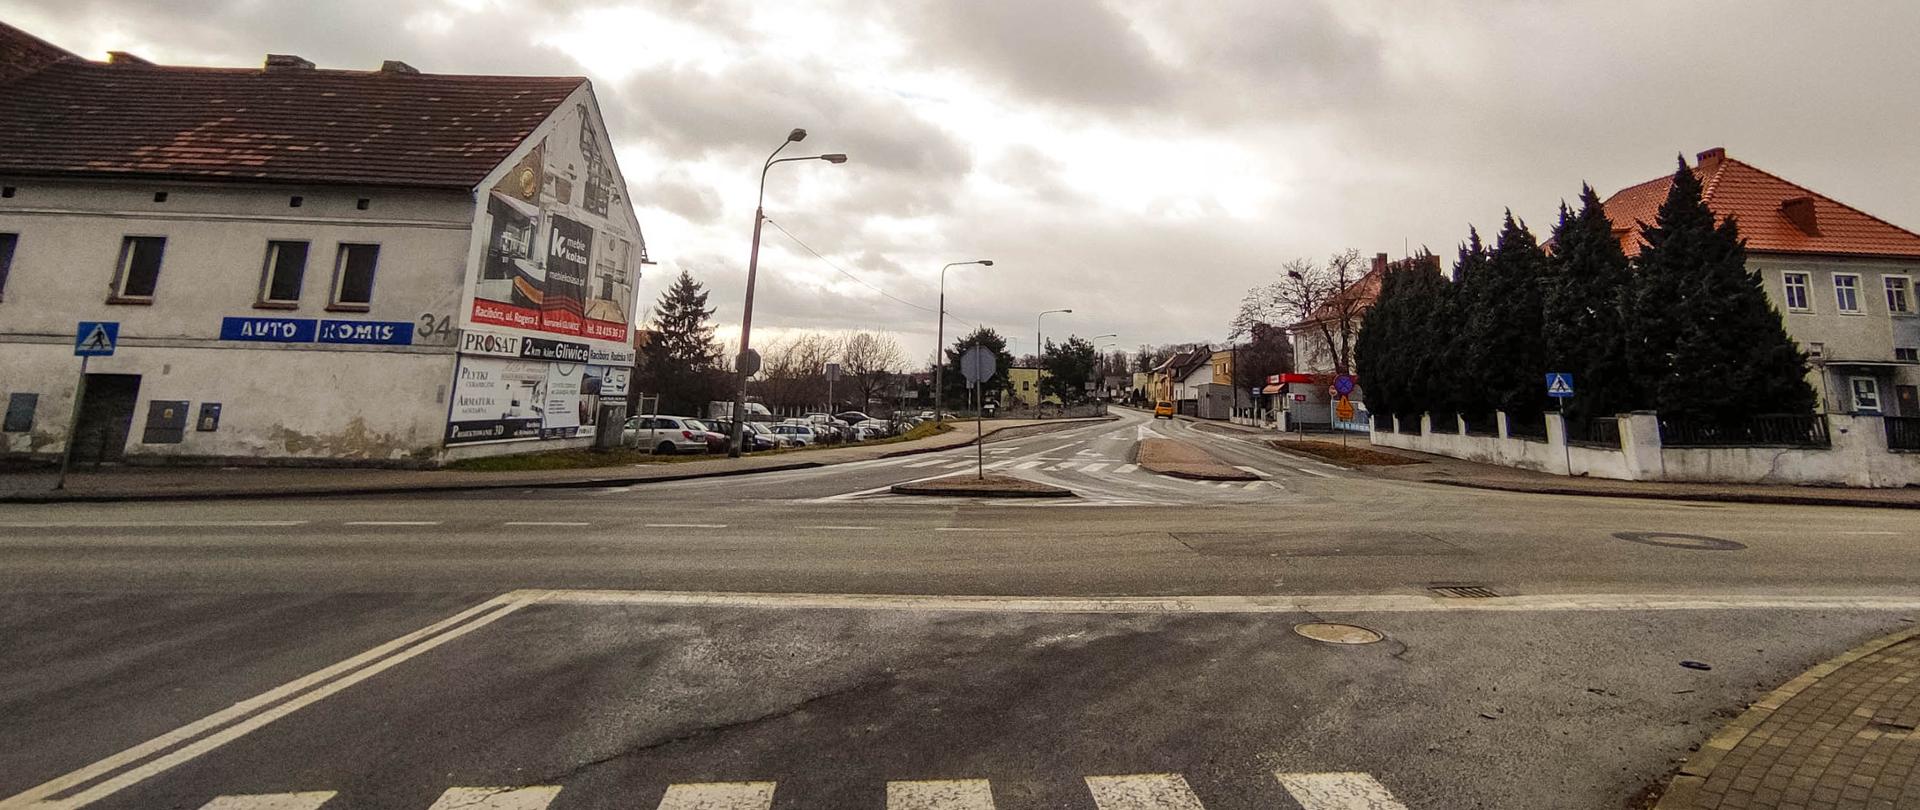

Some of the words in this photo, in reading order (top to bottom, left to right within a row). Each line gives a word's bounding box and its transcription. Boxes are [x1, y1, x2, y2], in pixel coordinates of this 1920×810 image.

[566, 238, 586, 251] meble
[565, 248, 587, 265] kolasa
[474, 305, 505, 321] Racibórz,
[241, 321, 297, 338] AUTO
[323, 324, 394, 341] KOMIS
[417, 312, 451, 341] 34
[586, 323, 595, 334] tel.
[465, 333, 518, 353] PROSAT
[524, 338, 532, 356] 2
[531, 346, 541, 356] km
[555, 342, 588, 361] Gliwice
[457, 394, 496, 407] ARMATURA
[494, 424, 505, 436] 3D
